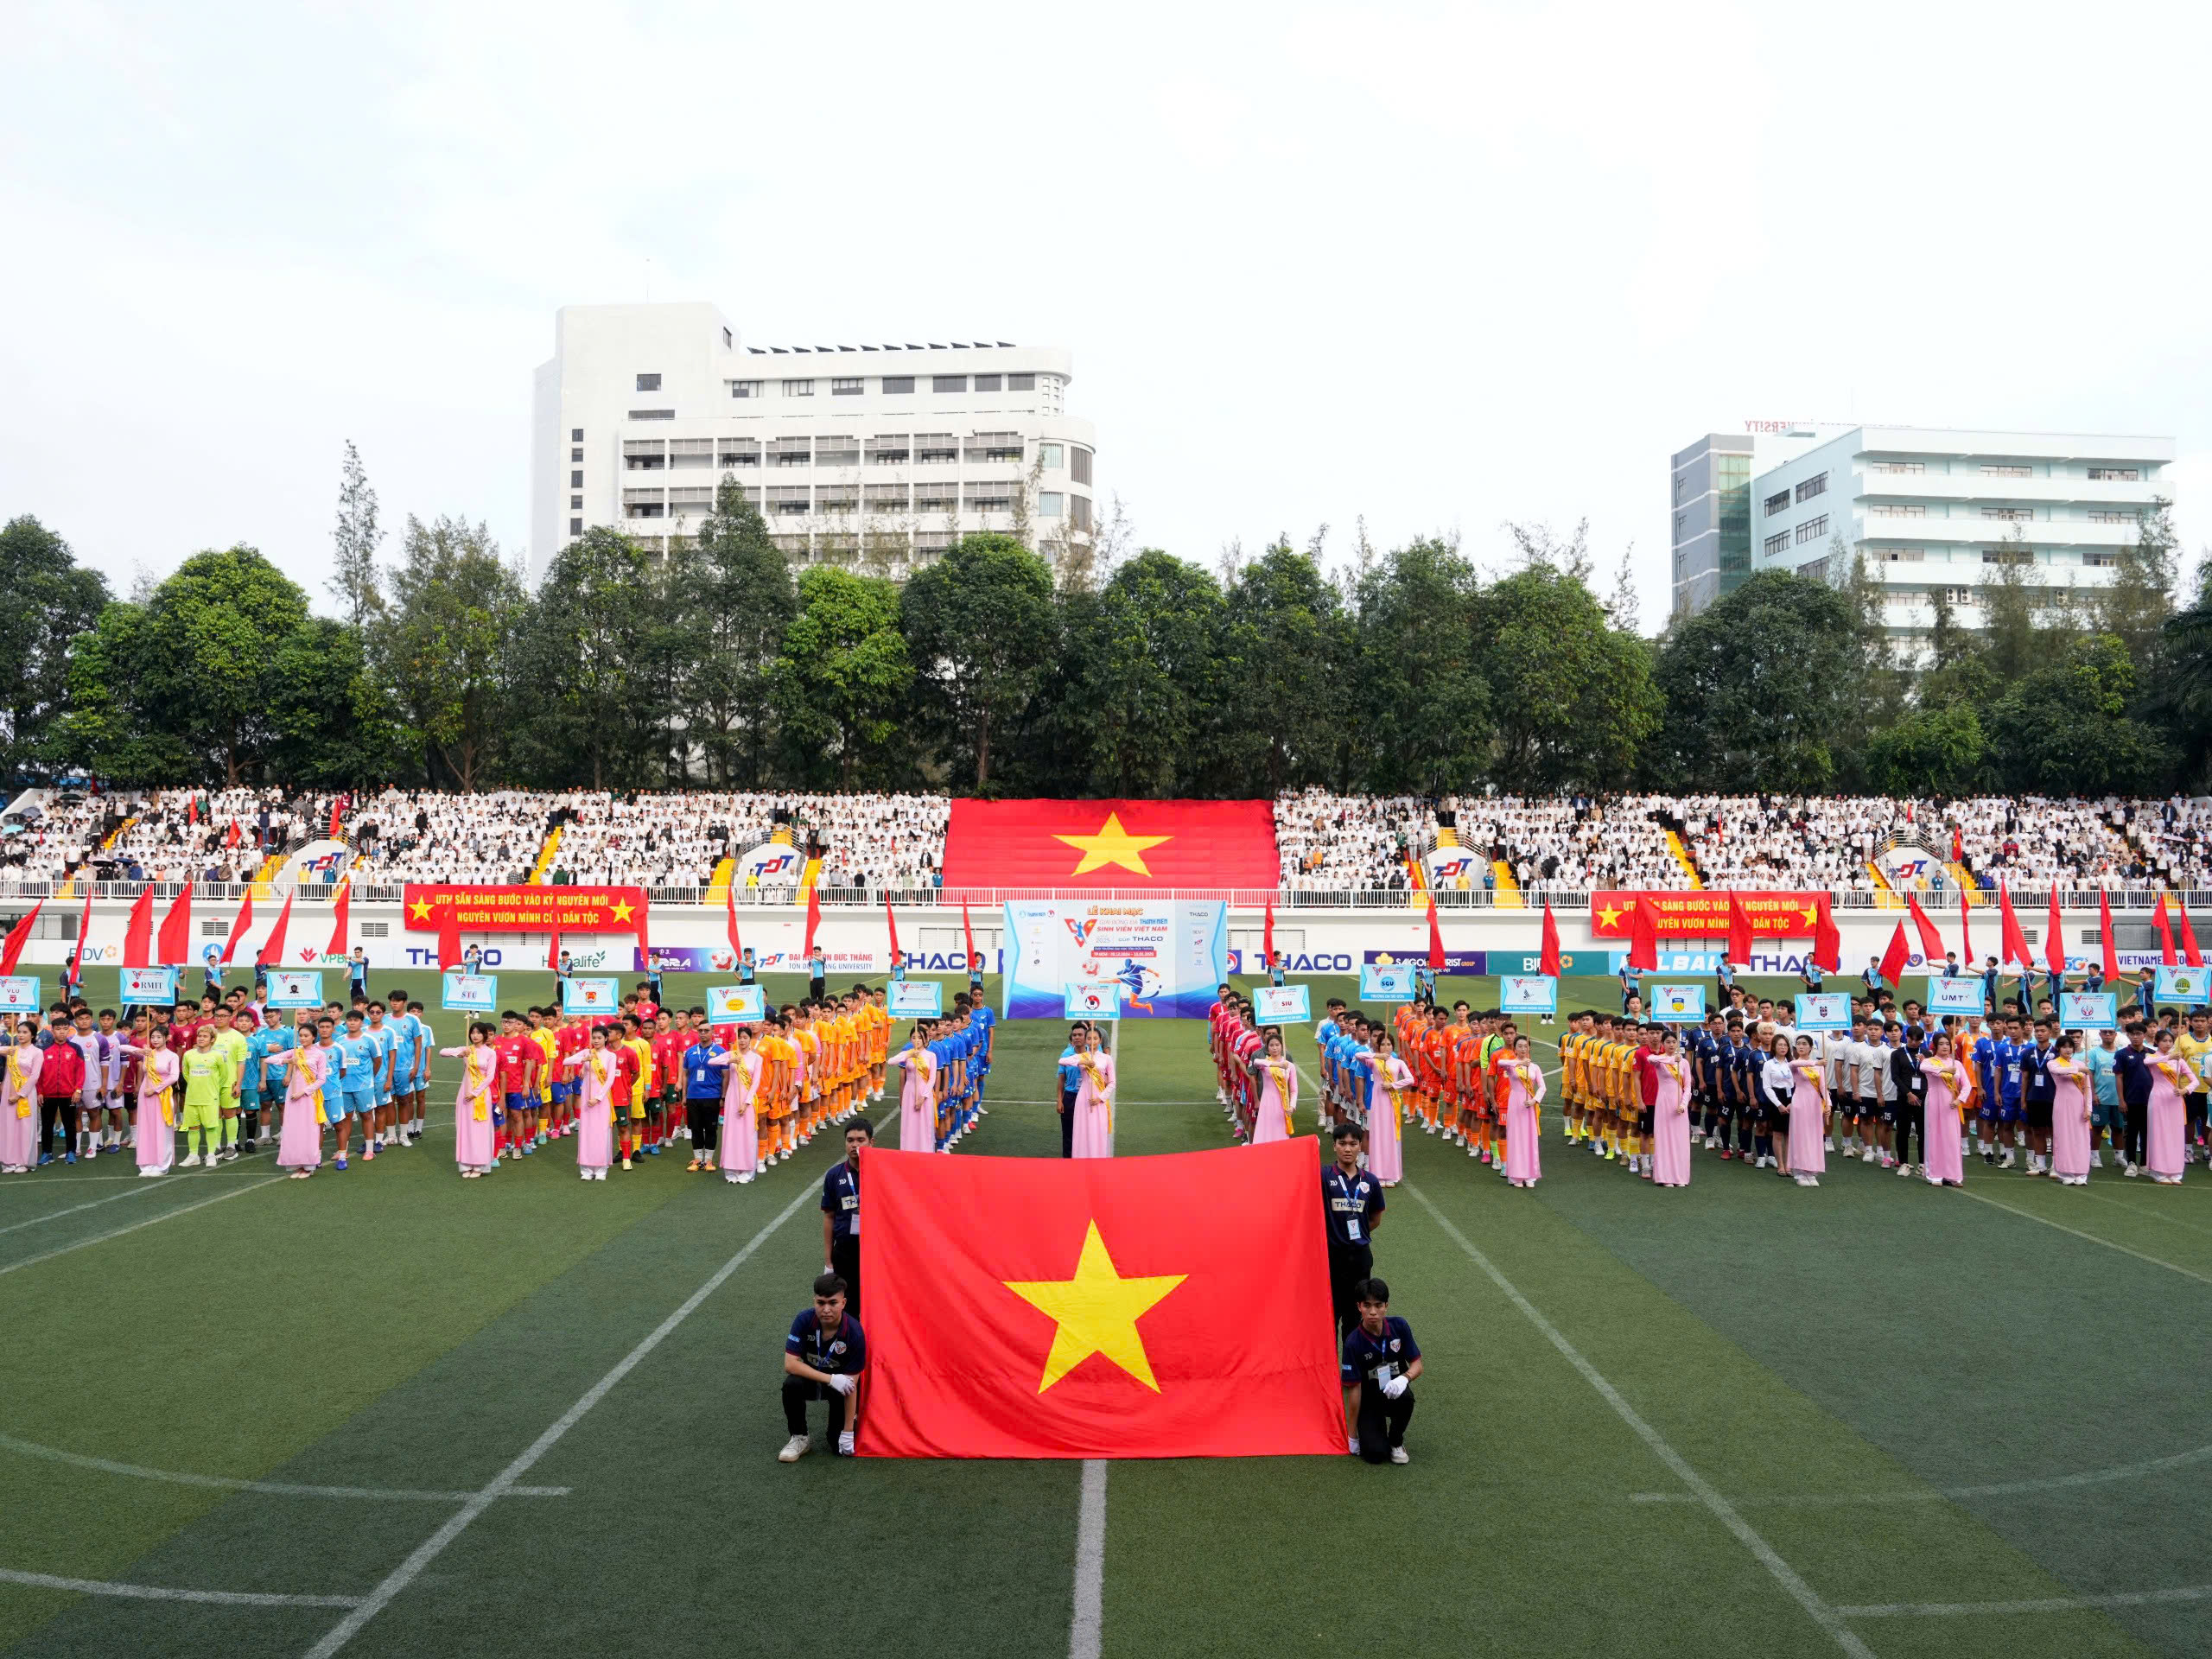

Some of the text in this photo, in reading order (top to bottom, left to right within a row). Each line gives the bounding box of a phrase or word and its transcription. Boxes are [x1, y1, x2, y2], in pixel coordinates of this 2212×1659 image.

[474, 893, 496, 906] SÀNG
[499, 893, 523, 906] BƯỚC
[524, 893, 542, 906] VÀO
[592, 894, 608, 906] MỚI
[1662, 899, 1684, 912] SÀNG
[1687, 899, 1710, 912] BƯỚC
[1713, 899, 1730, 912] VÀO
[1745, 899, 1777, 912] NGUYÊN
[1781, 900, 1798, 912] MỚI
[493, 911, 518, 923] VƯƠN
[518, 910, 541, 923] MÌNH
[563, 912, 580, 924] DÂN
[582, 912, 600, 925] TỘC
[1658, 917, 1789, 931] UYÊN VƯƠN MÌNH DÂN TỘC
[1758, 1109, 1764, 1117] 3
[1884, 1112, 1892, 1121] 15
